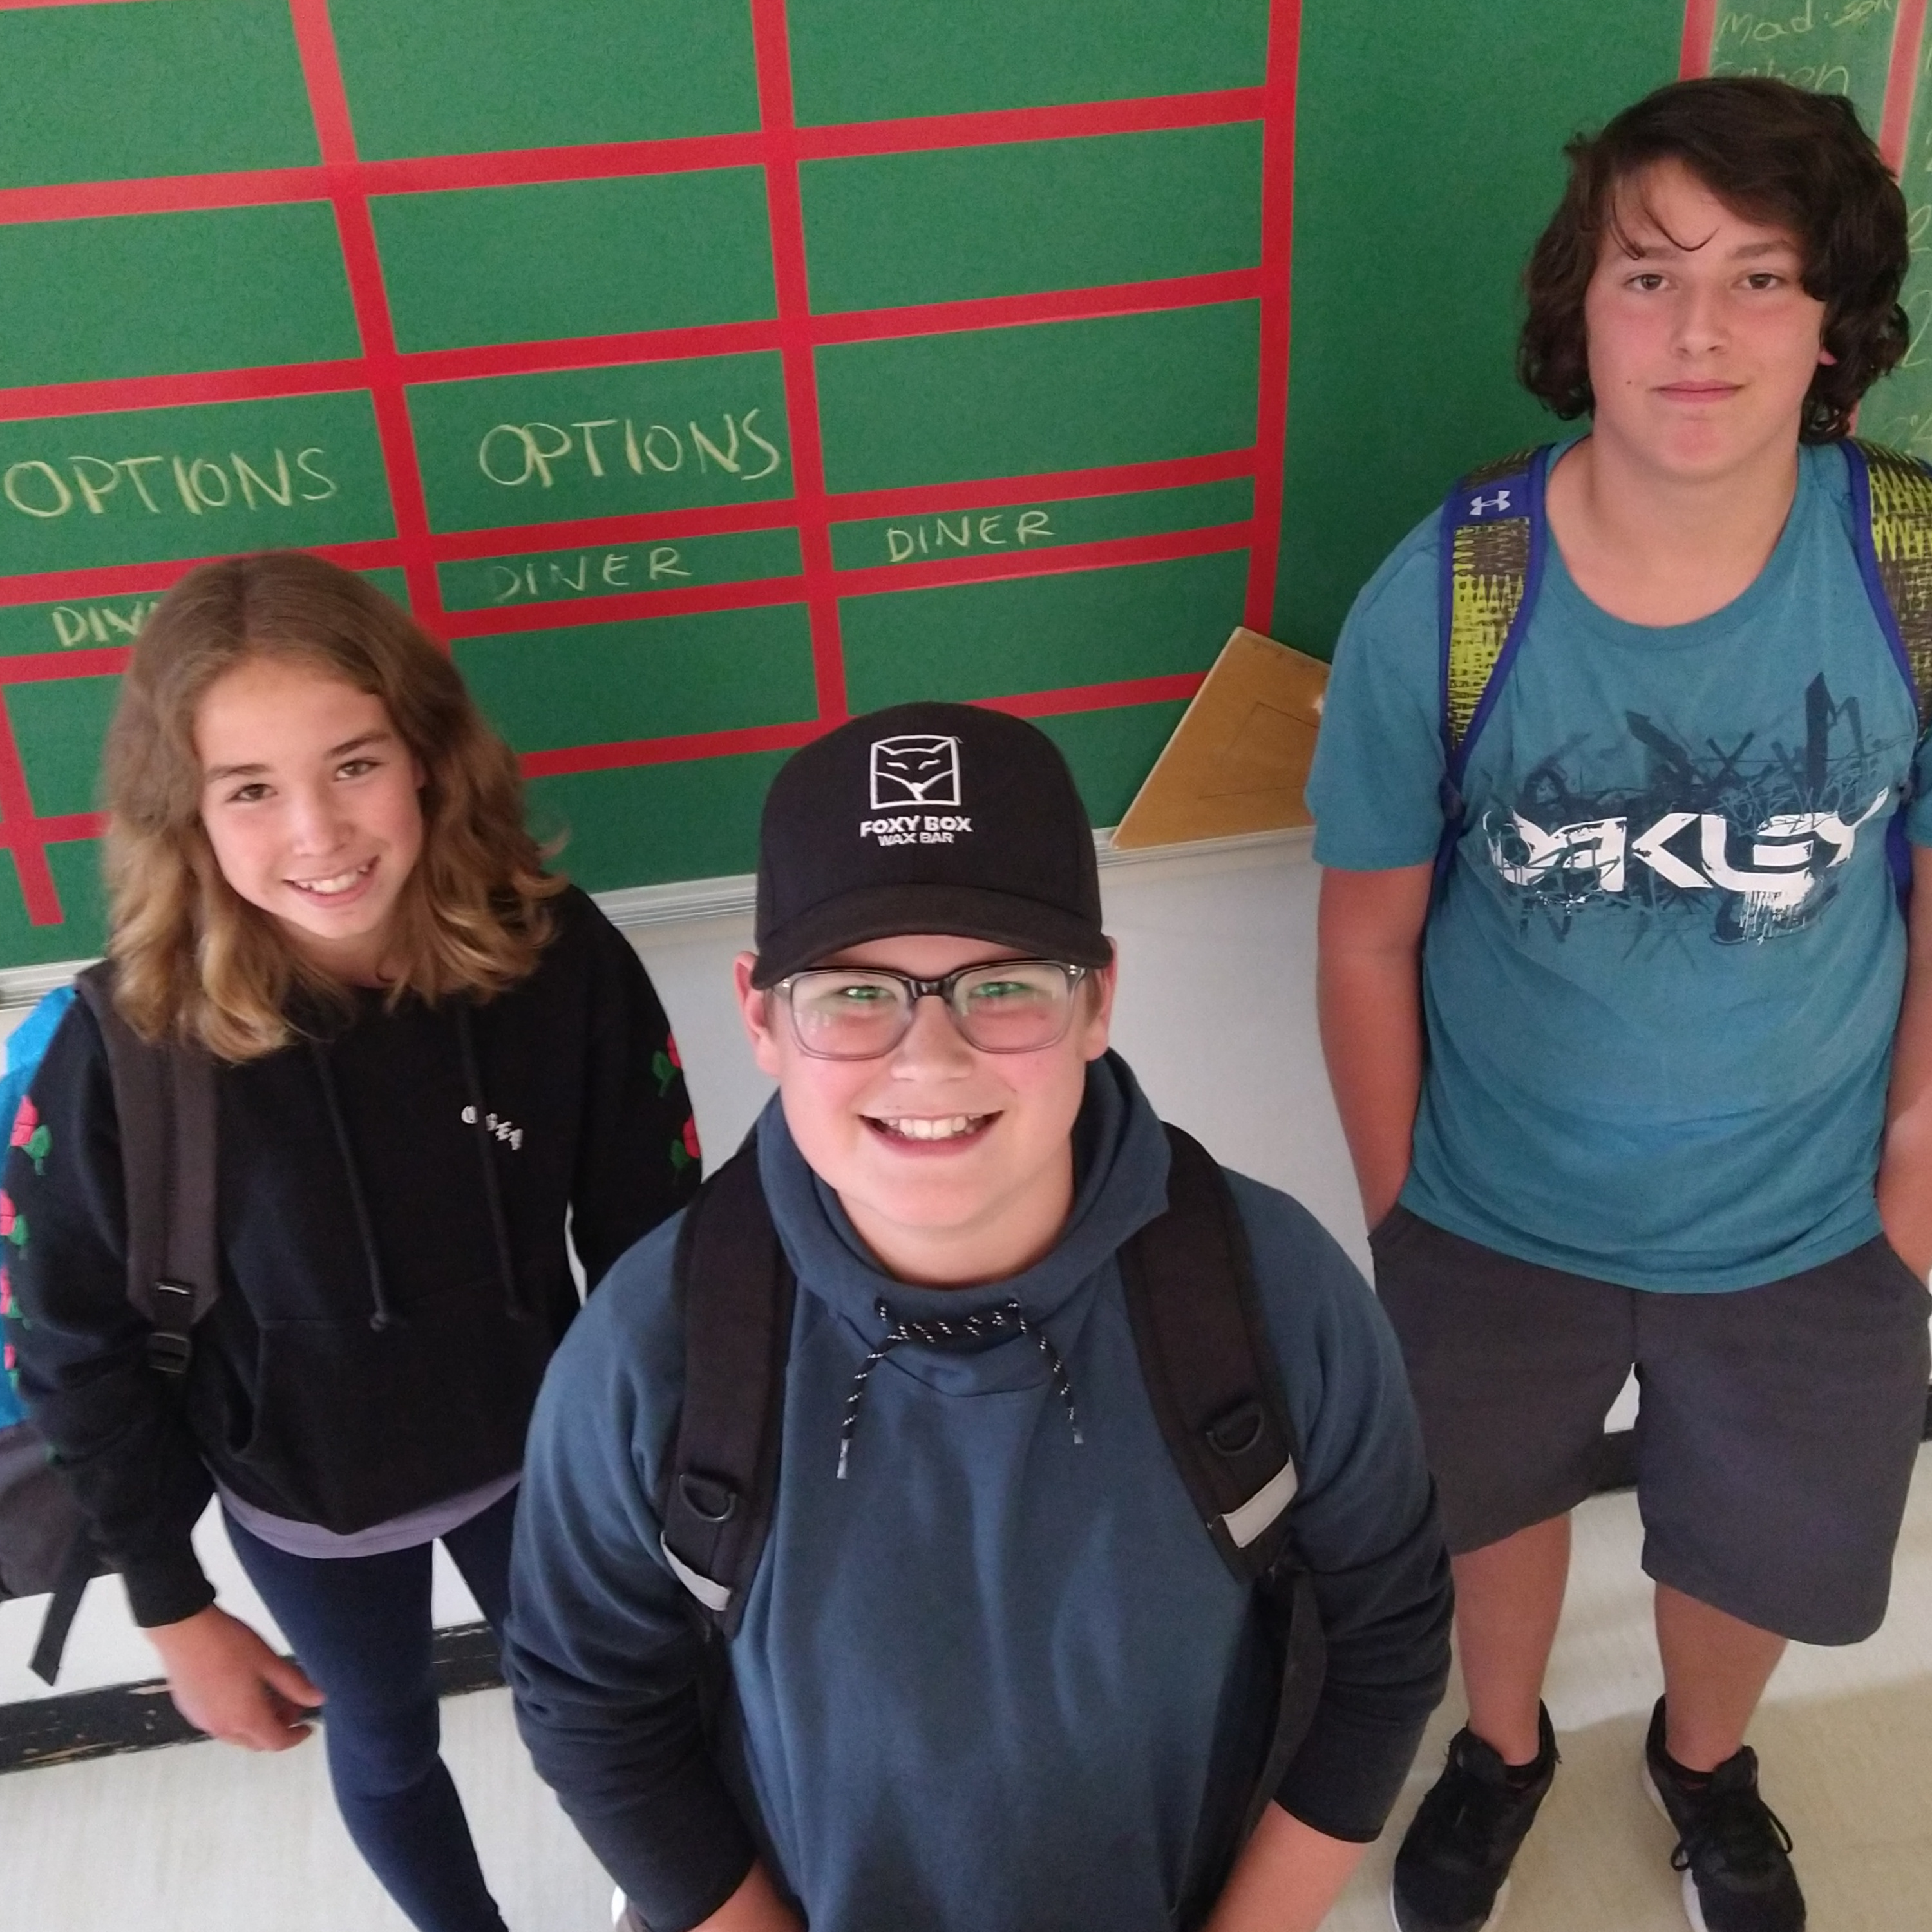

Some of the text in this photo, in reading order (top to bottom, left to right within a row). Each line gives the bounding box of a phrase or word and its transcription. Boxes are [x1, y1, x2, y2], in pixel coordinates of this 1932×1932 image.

[479, 408, 781, 488] OPTIONS
[4, 448, 337, 518] OPTIONS
[886, 510, 1056, 562] DINER
[51, 601, 159, 647] DIN
[860, 815, 973, 837] FOXY BOX
[877, 831, 954, 847] WAX BAR
